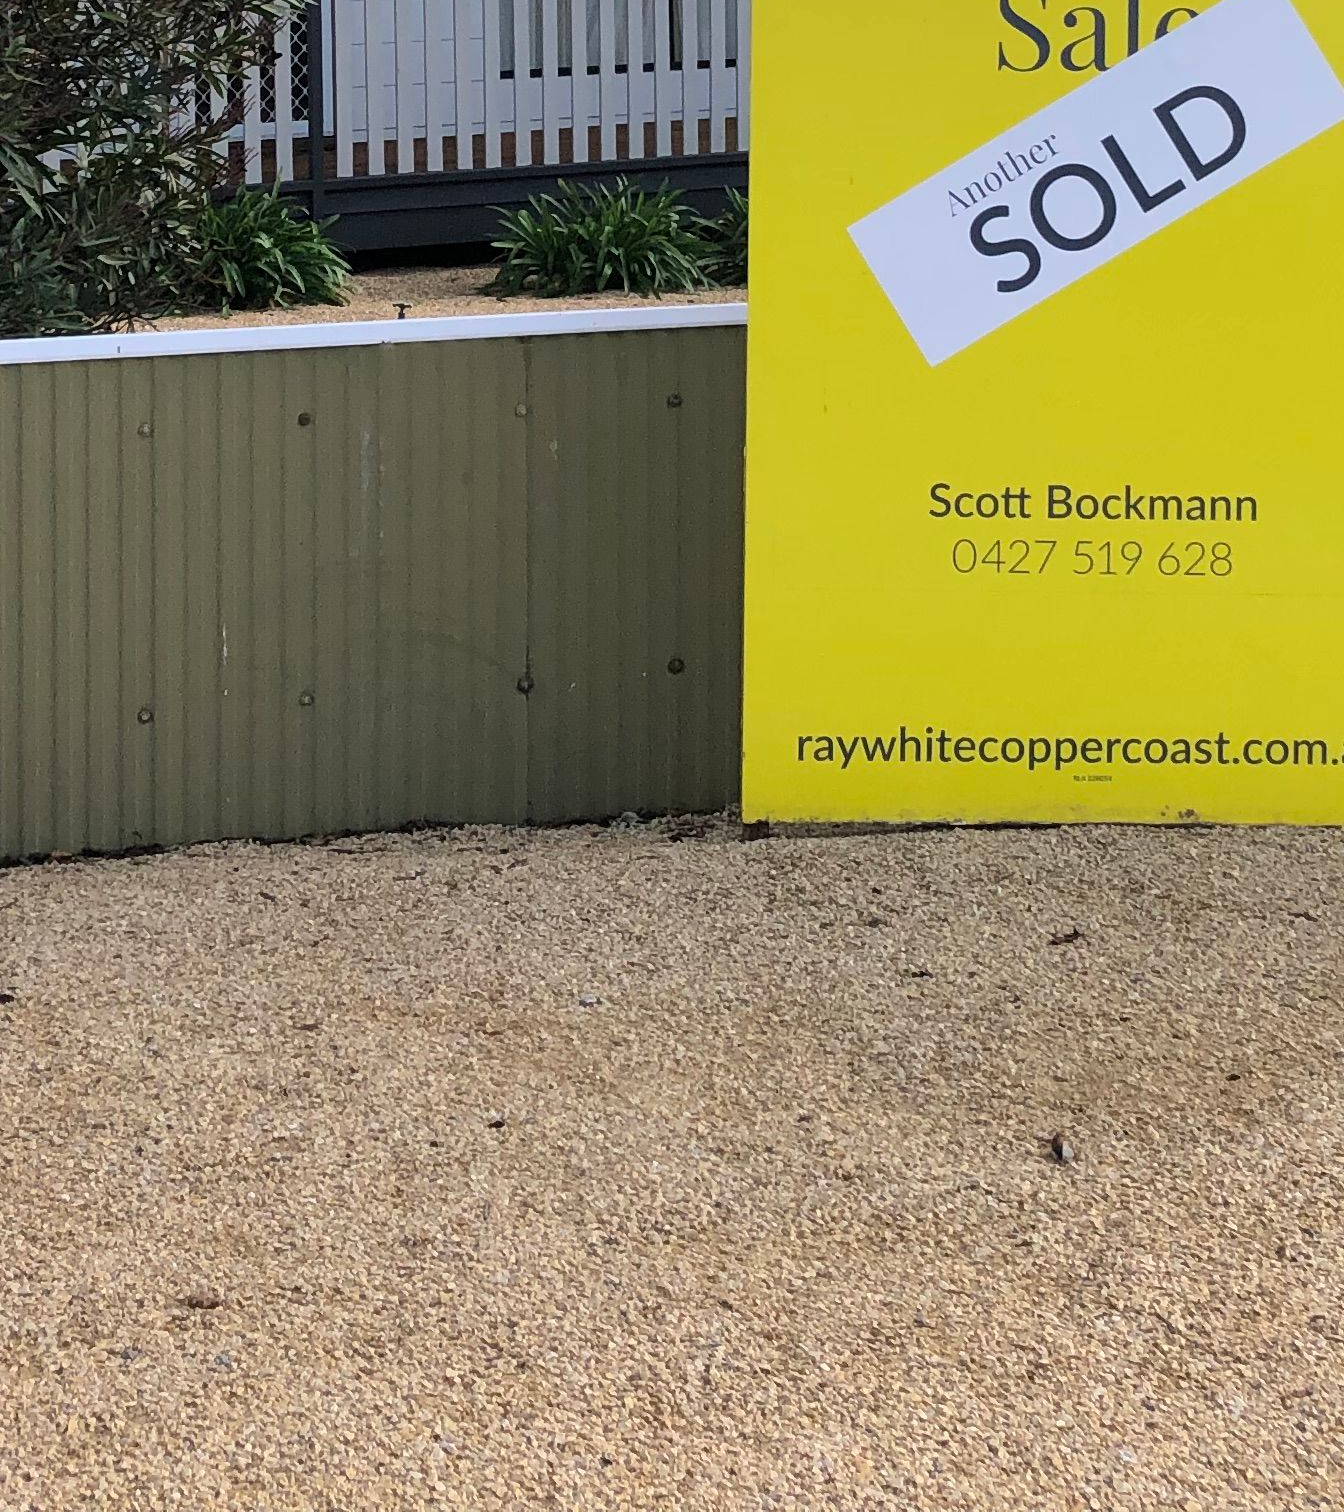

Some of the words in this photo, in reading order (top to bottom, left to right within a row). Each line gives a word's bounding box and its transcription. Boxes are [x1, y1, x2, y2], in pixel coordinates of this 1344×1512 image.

[948, 133, 1059, 218] Another
[969, 85, 1248, 294] SOLD
[927, 482, 1033, 519] Scott
[1047, 484, 1259, 522] Bockmann
[951, 539, 1058, 575] 0427
[1073, 540, 1144, 577] 519
[1157, 542, 1234, 578] 628
